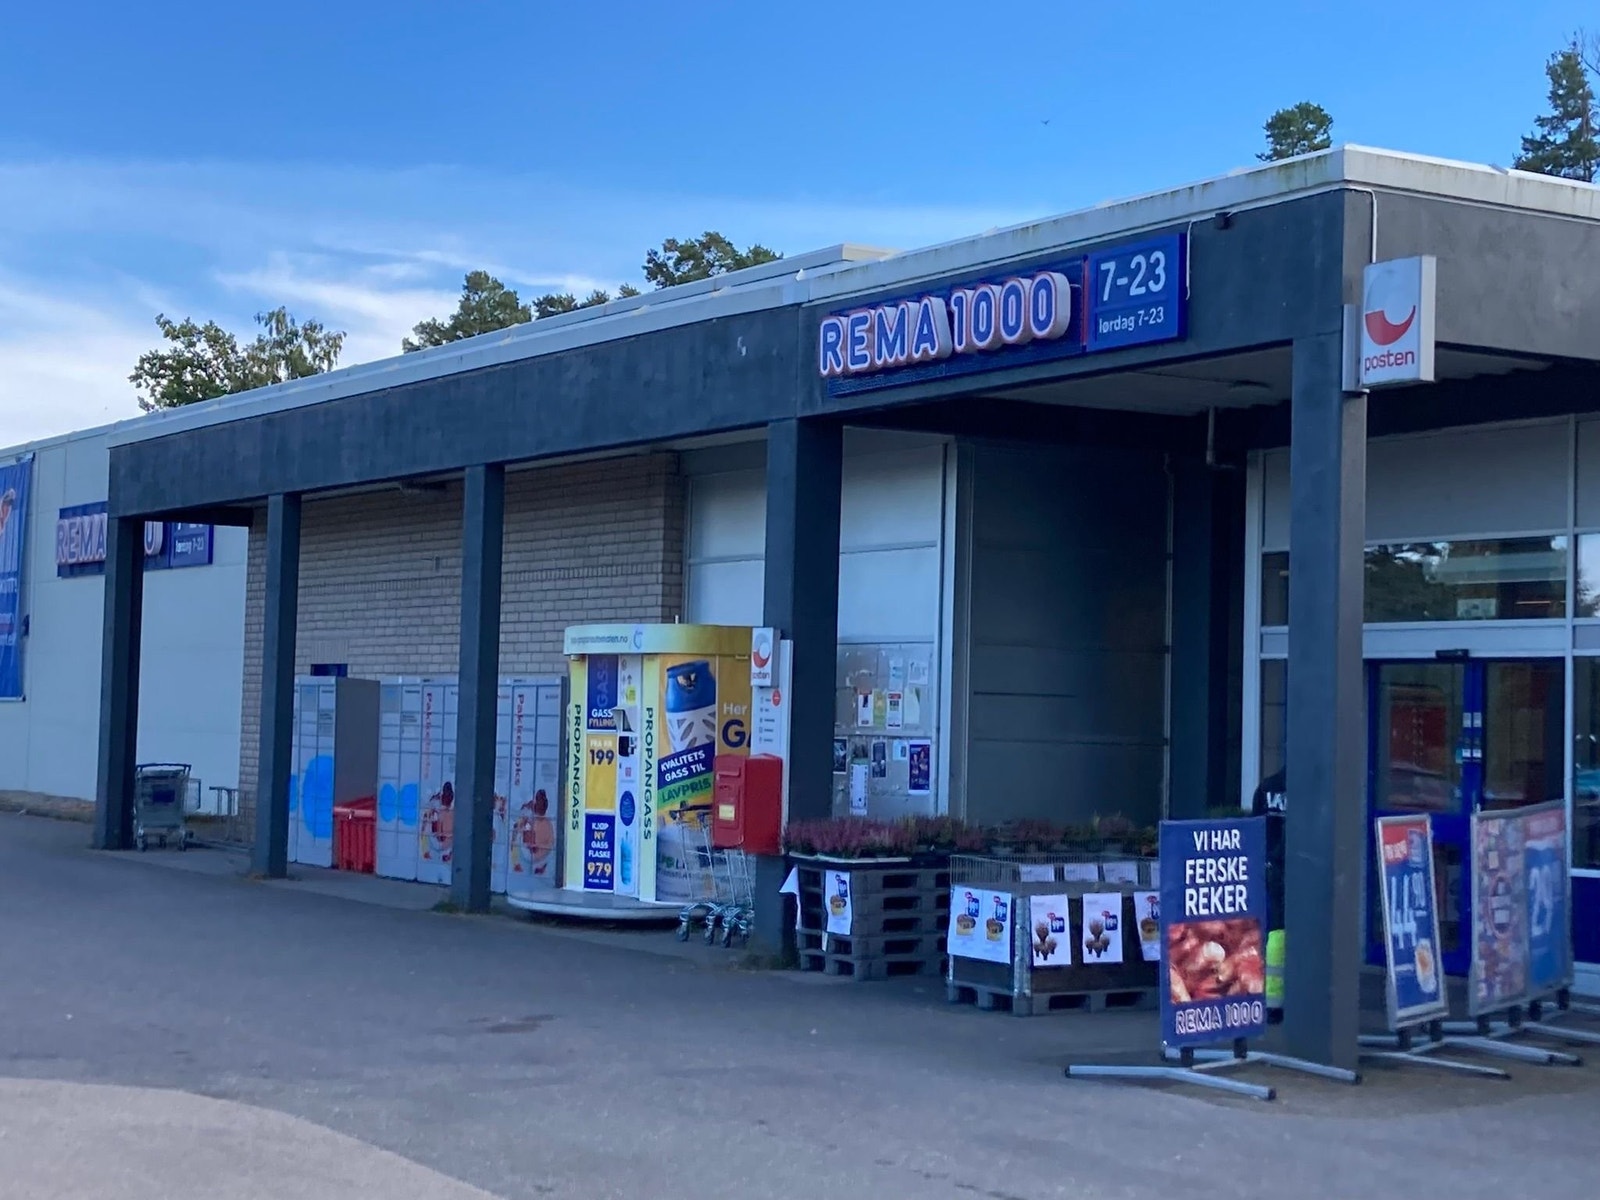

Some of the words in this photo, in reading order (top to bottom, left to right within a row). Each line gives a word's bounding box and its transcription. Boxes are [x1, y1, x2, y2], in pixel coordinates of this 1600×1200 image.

[1100, 250, 1166, 302] 7-23
[819, 296, 939, 376] REMA
[950, 271, 1060, 352] 1000
[1099, 312, 1135, 334] lørdag
[1138, 306, 1165, 326] 7-23
[1364, 350, 1415, 376] posten
[57, 514, 107, 563] REMA
[591, 708, 613, 718] GASS
[723, 702, 748, 716] Her
[571, 703, 582, 831] PROPANGASS
[589, 749, 615, 766] 199
[660, 750, 706, 773] KVALITETS
[642, 706, 654, 841] PROPANGASS
[664, 768, 689, 783] GASS
[692, 762, 706, 775] TIL
[662, 777, 712, 803] LAVPRIS
[1193, 830, 1208, 852] VI
[1211, 829, 1241, 851] HAR
[588, 850, 611, 859] FLASKE
[587, 862, 612, 877] 979
[1185, 856, 1249, 885] FERSKE
[1185, 884, 1248, 916] REKER
[1175, 1005, 1222, 1035] REMA
[1225, 1000, 1264, 1028] 1000
